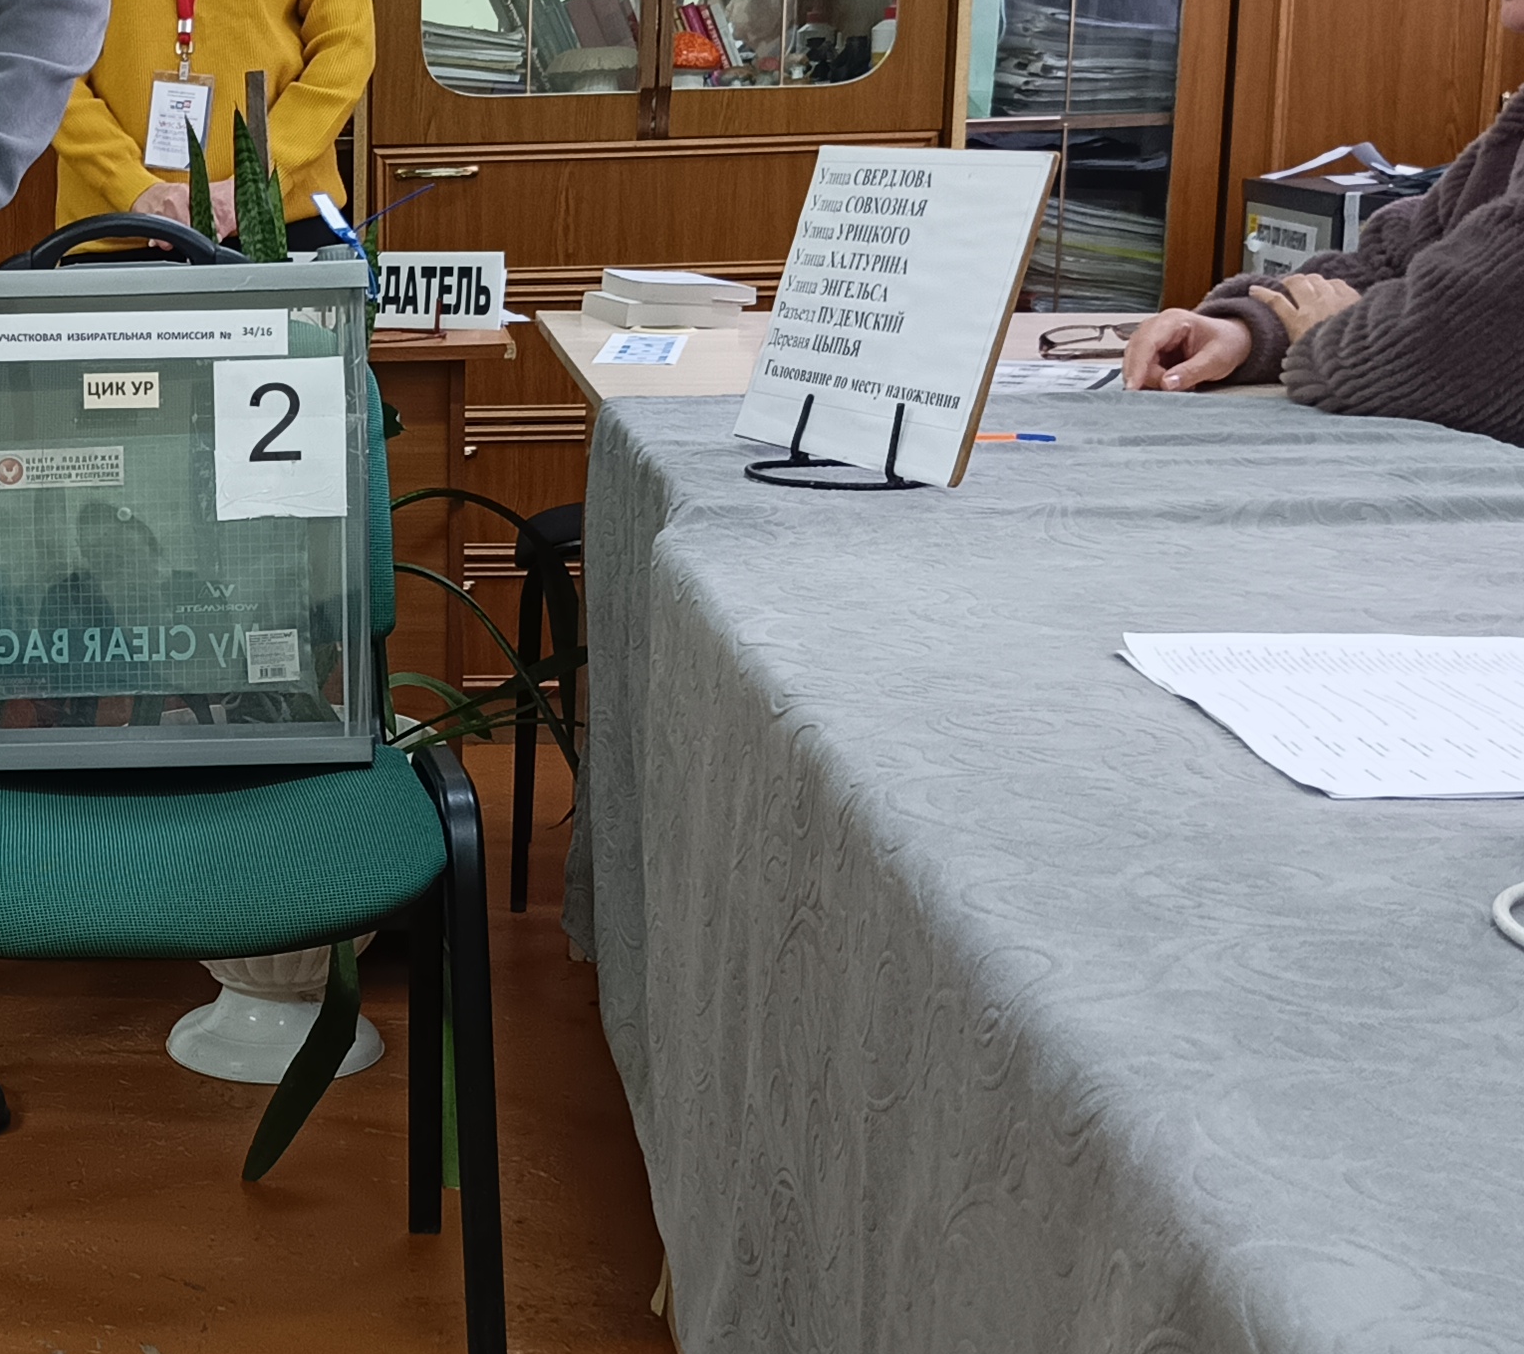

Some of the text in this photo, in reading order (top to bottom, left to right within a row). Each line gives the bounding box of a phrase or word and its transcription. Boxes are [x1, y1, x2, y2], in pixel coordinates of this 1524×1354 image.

[819, 167, 933, 189] Улица СВЕРДЛОВА
[810, 194, 928, 217] Улица СОВХОЗНАЯ
[802, 220, 911, 246] Улица УРИЦКОГО
[794, 248, 909, 275] Улица ХАЛТУРИНА
[376, 265, 491, 316] ДАТЕЛЬ
[785, 274, 888, 303] Улица ЭНГЕЛЬСА
[777, 301, 905, 334] Разъезд ПУДЕМСКИЙ
[67, 331, 152, 342] ИЗБИРАТЕЛЬНАЯ
[157, 330, 215, 341] КОМИССИЯ
[220, 330, 232, 340] №
[242, 326, 273, 338] 34/16
[768, 327, 862, 358] Деревня ЦЫПЬЯ
[87, 380, 155, 399] ЦИК УР
[764, 359, 961, 410] Голосование по месту нахождения
[249, 381, 303, 464] 2
[25, 454, 119, 465] ЦЕНТР ПОДДЕРЖКИ
[25, 463, 120, 473] ПРЕДПРИНИМАТЕЛЬСТВА
[26, 470, 120, 482] УДМУРТСКОЙ РЕСПУБЛИКИ
